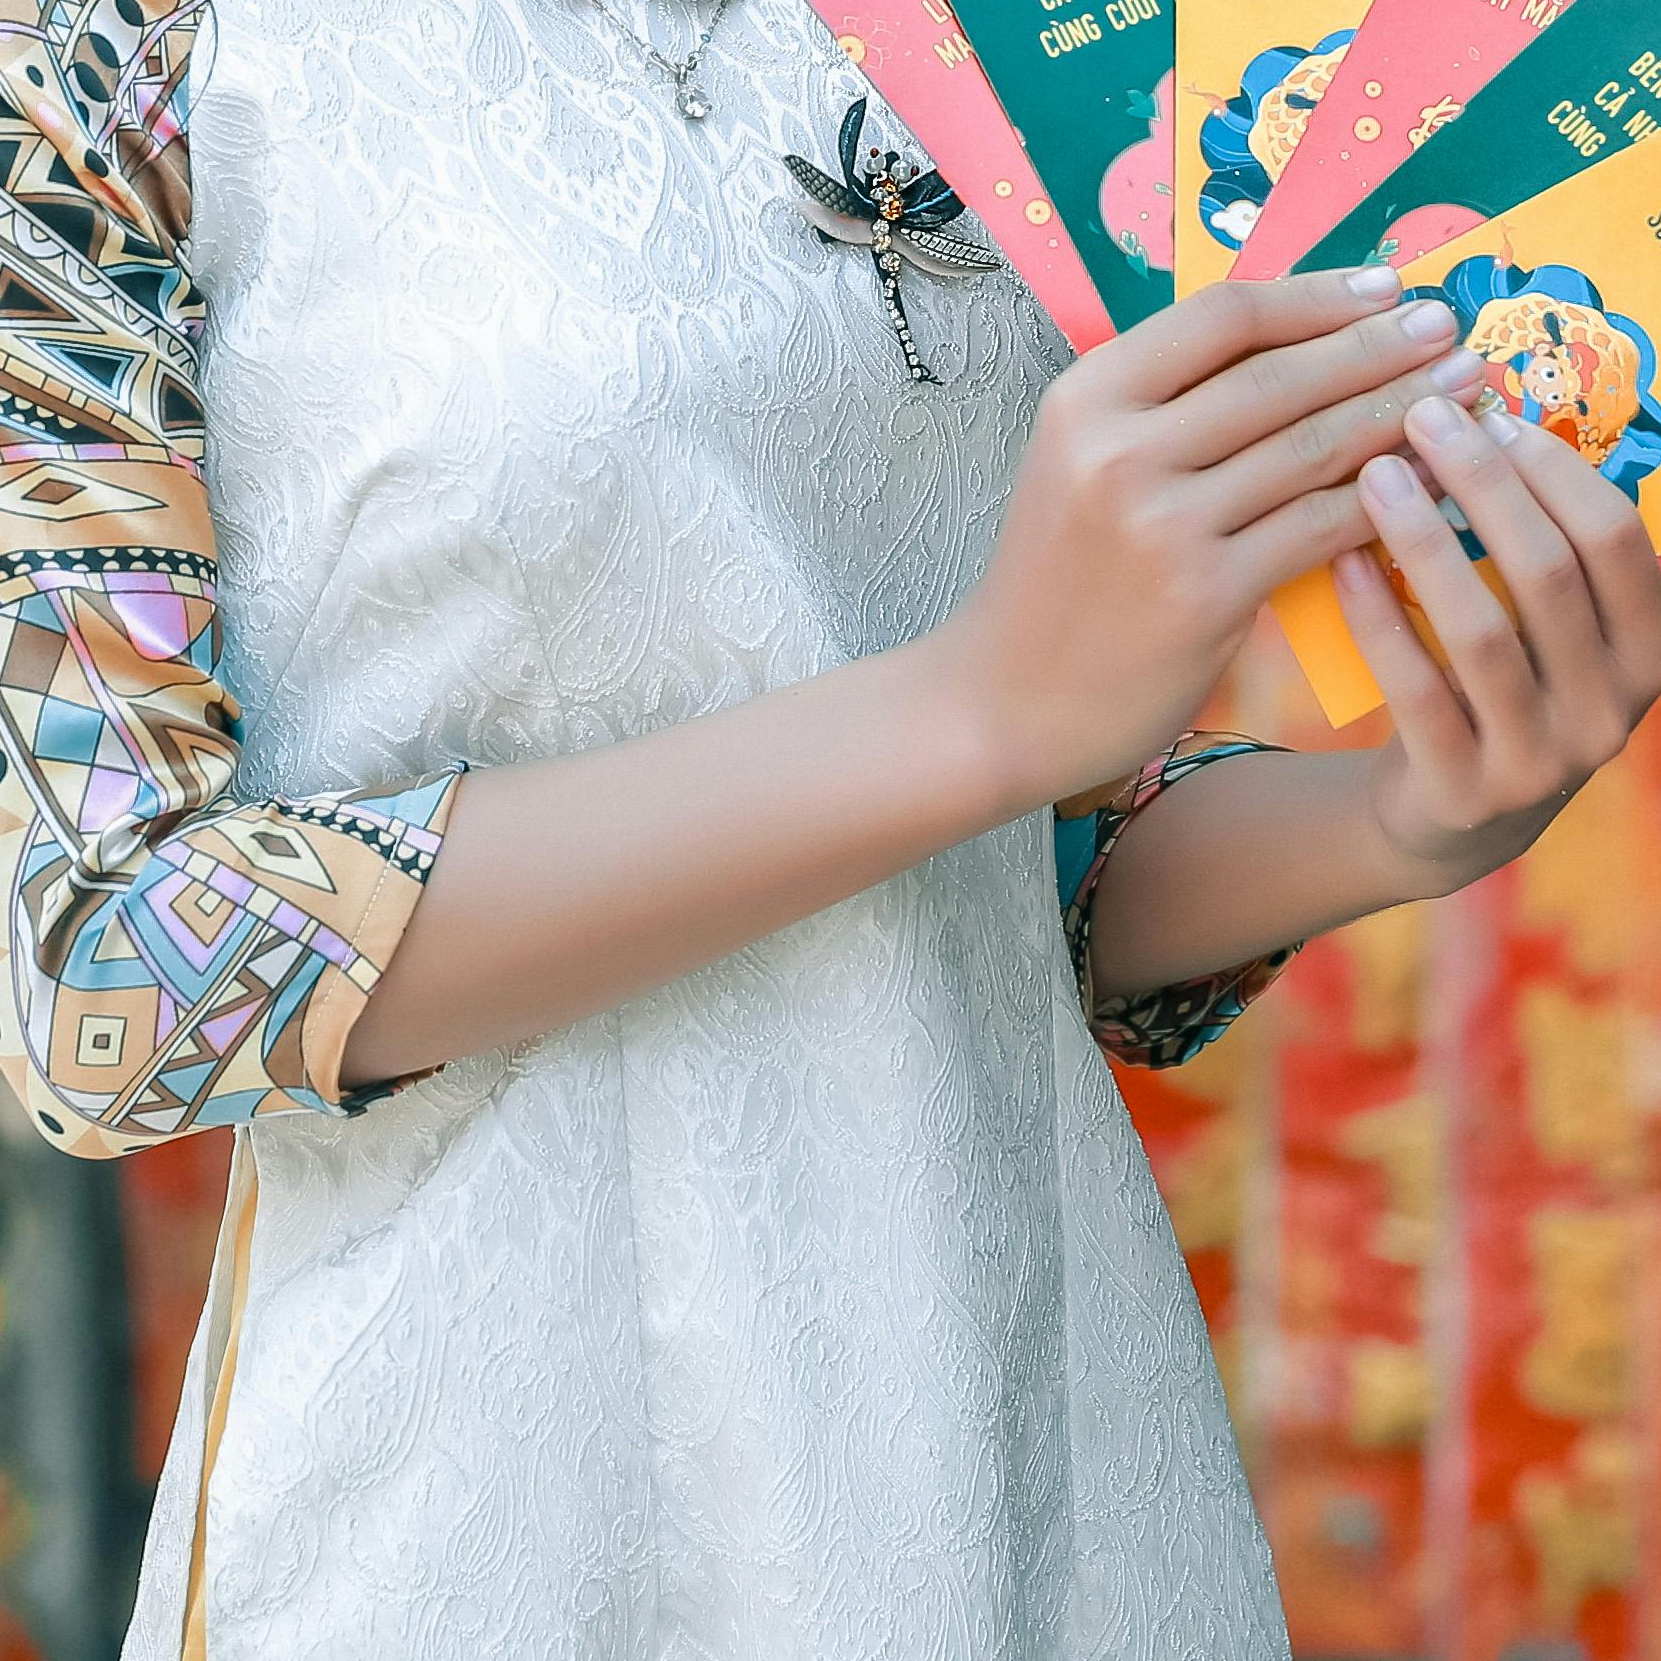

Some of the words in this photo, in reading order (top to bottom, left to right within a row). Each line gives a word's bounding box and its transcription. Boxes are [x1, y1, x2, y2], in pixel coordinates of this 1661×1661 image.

[1039, 13, 1102, 58] CÙNG
[1594, 81, 1636, 118] CẢ
[1547, 100, 1606, 157] CÙNG
